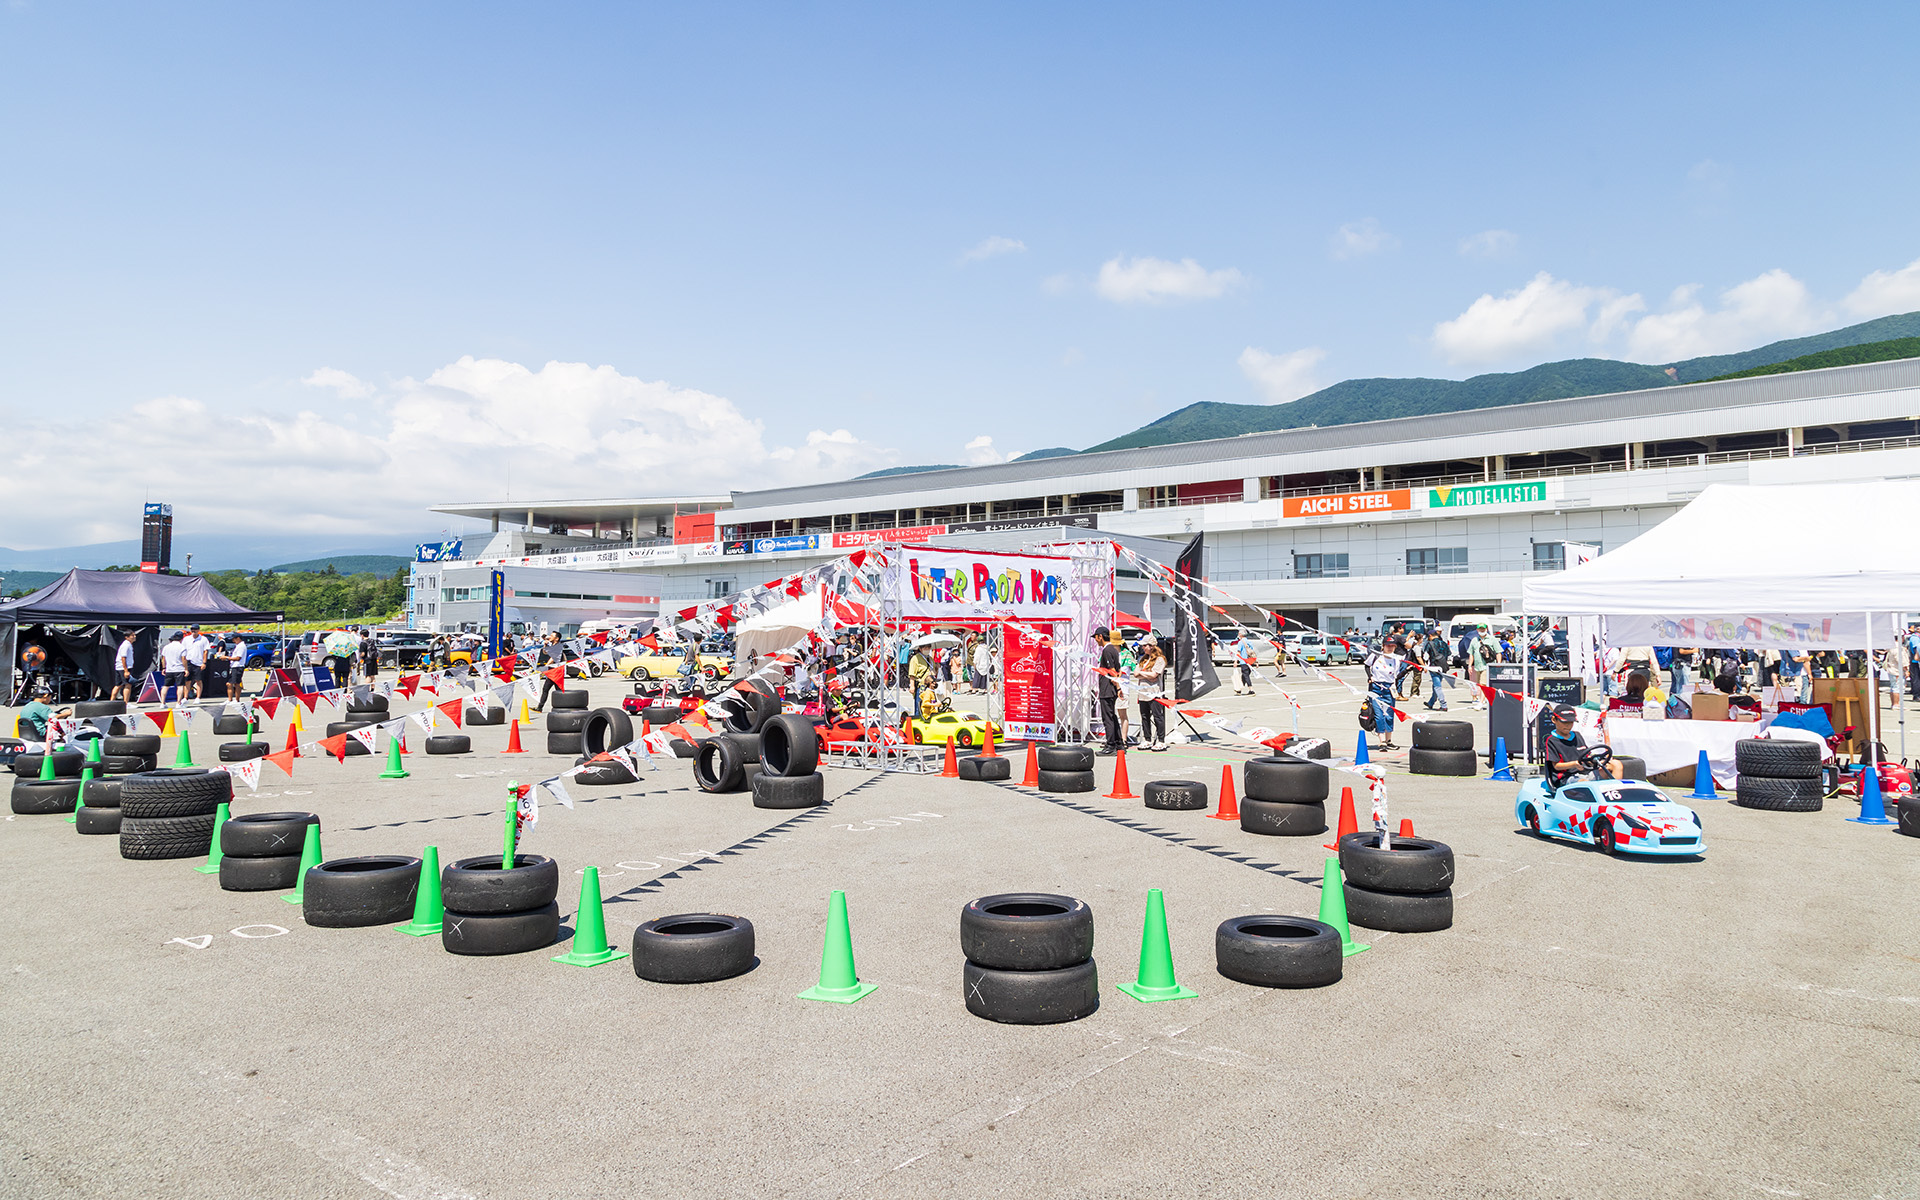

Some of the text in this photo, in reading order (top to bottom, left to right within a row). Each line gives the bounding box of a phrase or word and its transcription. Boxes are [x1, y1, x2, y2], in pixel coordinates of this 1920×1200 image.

[1300, 493, 1392, 514] AICHI STEEL
[1456, 485, 1539, 507] MODELLISTA
[909, 558, 1062, 605] INTER PROTO KIDS
[1604, 789, 1623, 801] 16
